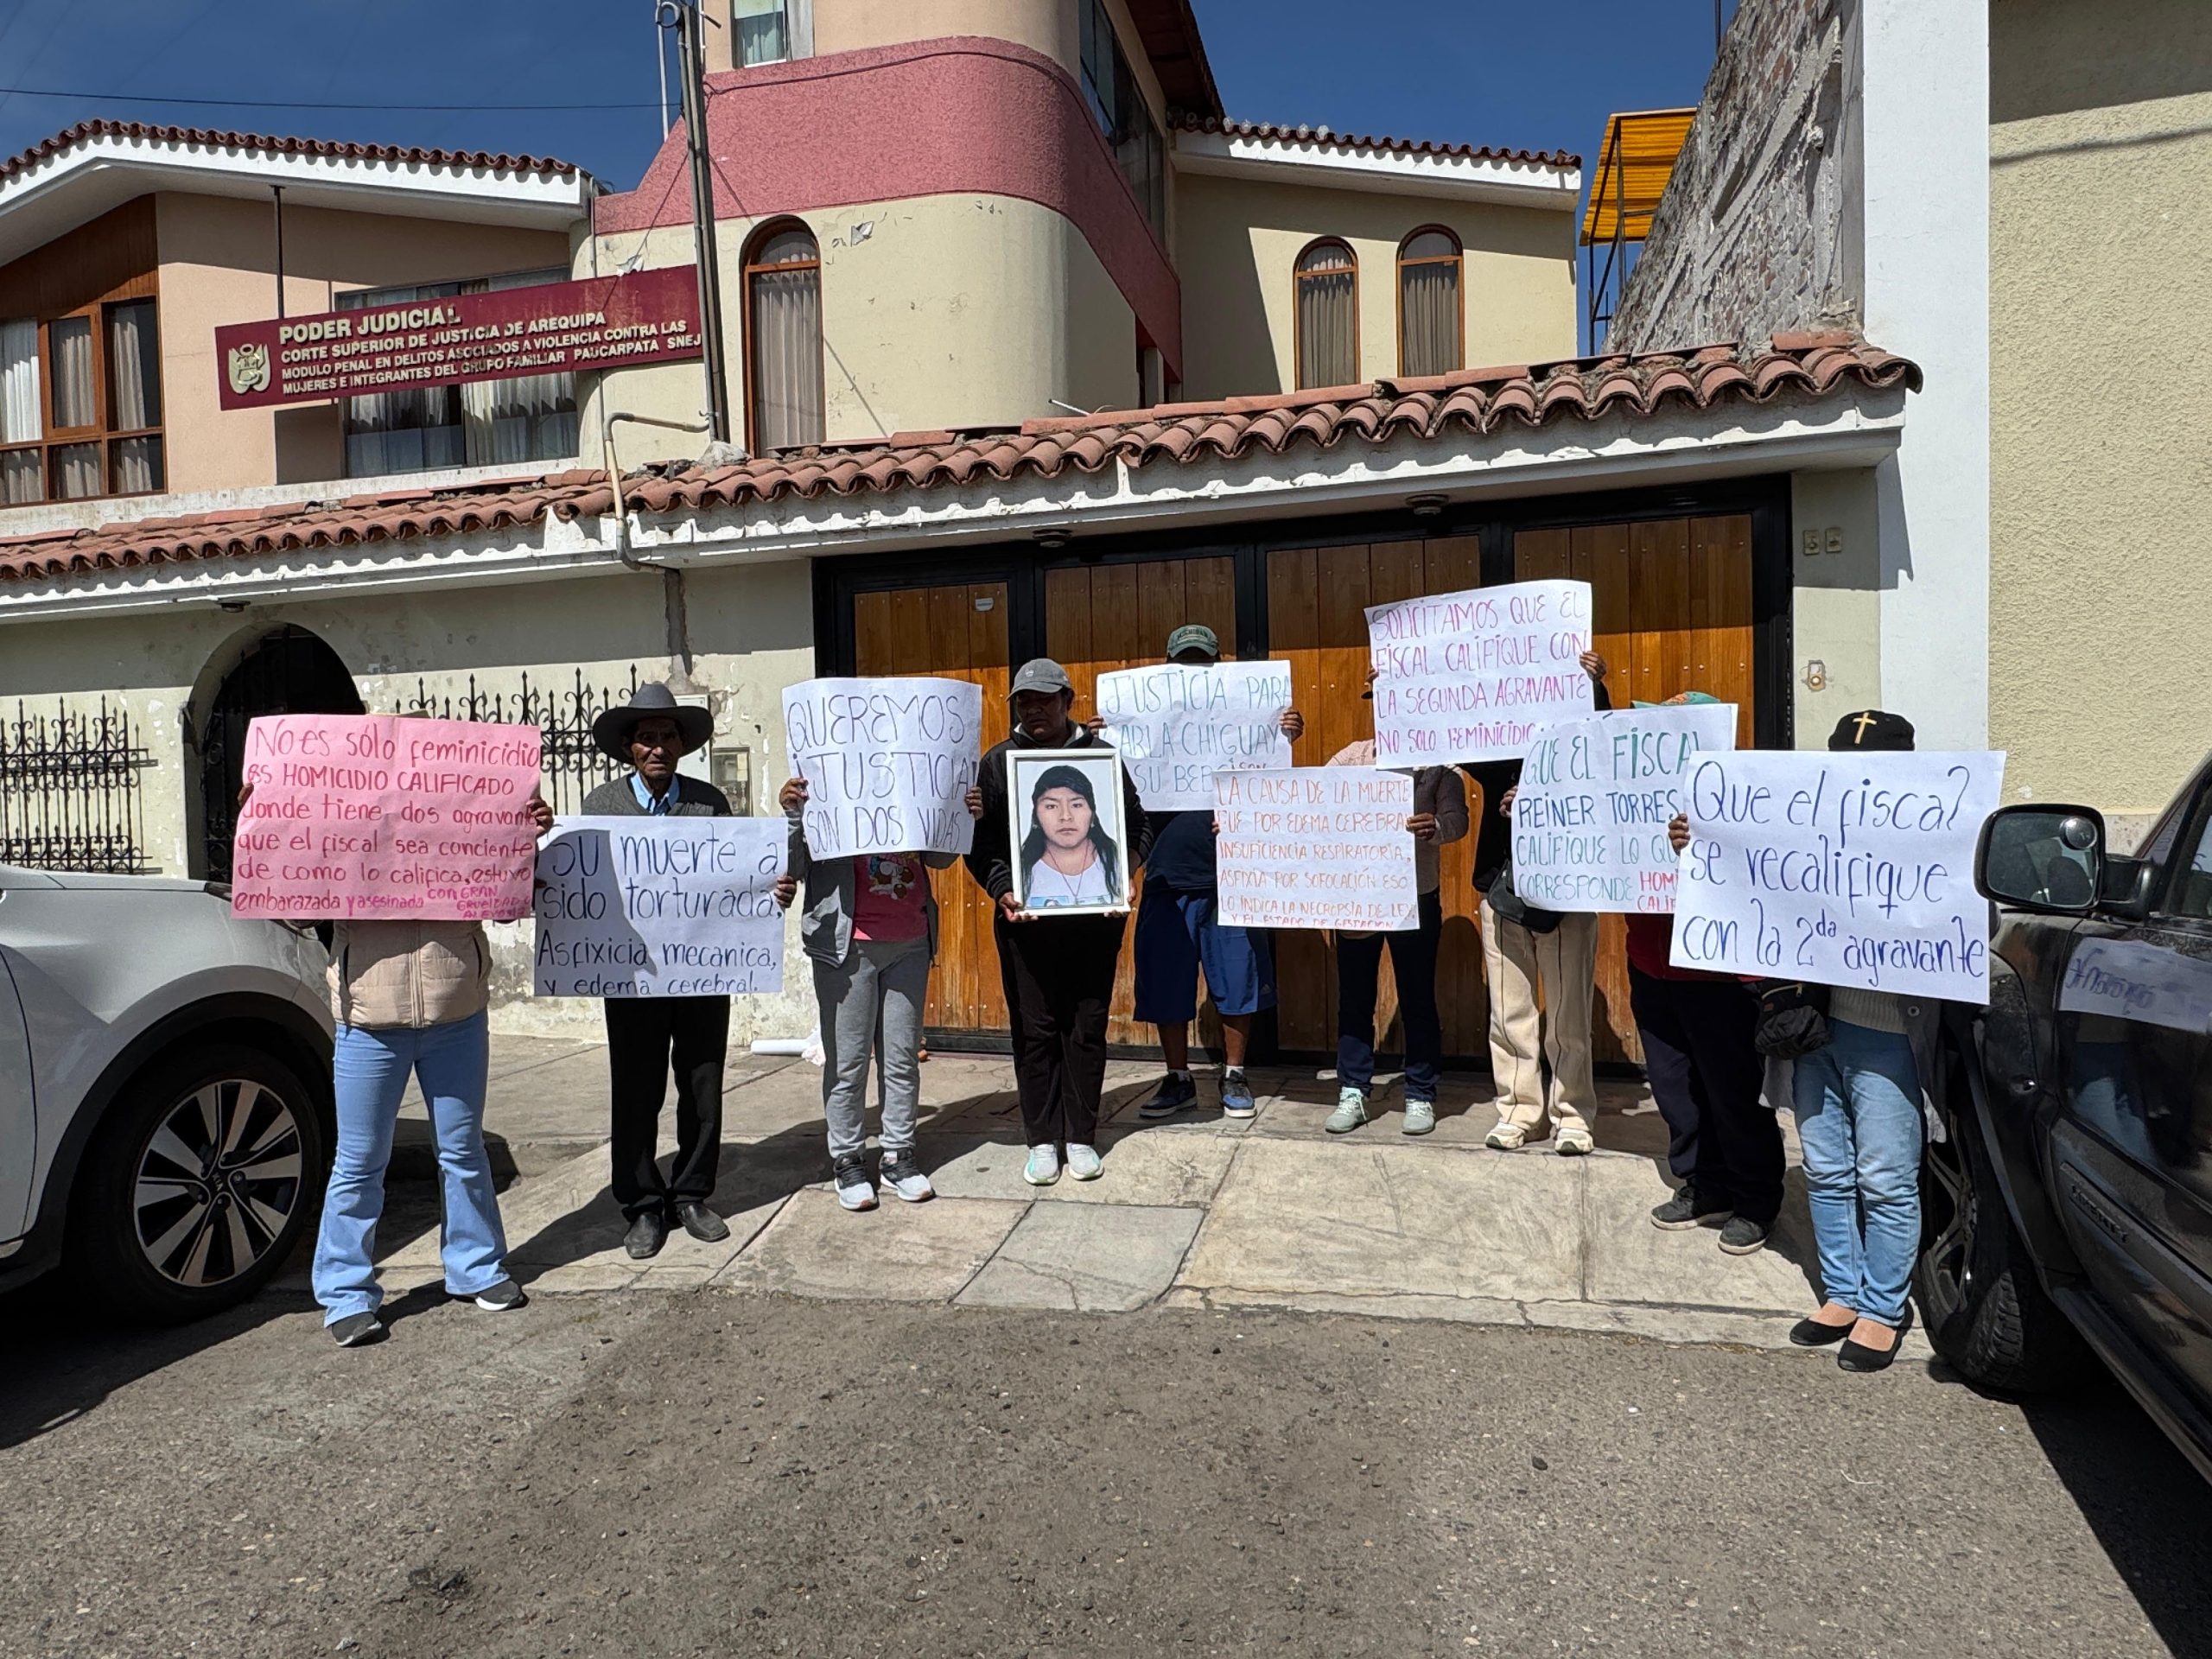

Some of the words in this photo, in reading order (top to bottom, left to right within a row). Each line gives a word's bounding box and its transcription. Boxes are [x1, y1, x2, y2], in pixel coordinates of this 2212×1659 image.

[279, 319, 352, 344] PODER
[357, 305, 461, 335] JUDICIAL
[281, 346, 328, 364] CORTE
[331, 337, 405, 358] SUPERIOR
[409, 334, 428, 348] DE
[431, 323, 499, 346] JUSTICIA
[505, 321, 524, 337] DE
[528, 311, 607, 333] AREQUIPA
[282, 363, 332, 379] MODULO
[334, 358, 372, 374] PENAL
[375, 355, 391, 370] EN
[394, 349, 445, 367] DELITOS
[448, 342, 519, 361] ASOCIADOS
[522, 339, 532, 351] A
[533, 330, 601, 350] VIOLENCIA
[604, 323, 658, 341] CONTRA
[661, 319, 687, 334] LAS
[283, 378, 337, 395] MUJERES
[340, 377, 347, 388] E
[350, 366, 432, 387] INTEGRANTES
[435, 363, 458, 377] DEL
[461, 357, 505, 374] GRUPO
[506, 351, 565, 369] FAMILIAR
[574, 340, 659, 360] PAUCARPATA
[667, 334, 702, 350] SNEJ
[1510, 594, 1547, 625] QUE
[1560, 591, 1586, 619] EL
[1376, 643, 1435, 680] FISCAL
[1549, 630, 1588, 661] CON
[1246, 675, 1291, 709] PARA
[1376, 689, 1397, 719] LA
[1405, 681, 1488, 715] SEGUNDA
[1494, 672, 1587, 707] AGRAVANTE
[787, 694, 964, 752] QUEREMOS
[1378, 729, 1400, 755] NO
[1408, 728, 1437, 753] SOLO
[346, 722, 396, 760] sólo
[410, 739, 540, 768] feminicidio
[1570, 735, 1596, 780] EL
[283, 762, 388, 791] HOMICIDIO
[397, 770, 515, 796] CALIFICADO
[1134, 764, 1160, 793] SU
[1174, 764, 1227, 793] BEB
[1216, 776, 1241, 806] LA
[1247, 777, 1300, 804] CAUSA
[1306, 779, 1325, 804] DE
[1333, 780, 1352, 804] LA
[1357, 779, 1410, 804] MUERTE
[1693, 760, 1771, 823] Que
[1787, 770, 1826, 827] el
[321, 793, 382, 821] tiene
[401, 800, 440, 824] dos
[1217, 810, 1242, 834] FUE
[1254, 810, 1282, 835] POR
[1287, 811, 1331, 834] EDEMA
[1336, 812, 1408, 833] CEREBRA
[1518, 791, 1596, 829] REINER
[1605, 789, 1679, 825] TORRES
[238, 832, 280, 855] que
[289, 826, 311, 851] el
[321, 830, 378, 858] fiscal
[395, 840, 429, 856] sea
[438, 836, 533, 858] conciente
[620, 822, 735, 875] muerte
[758, 842, 779, 875] a
[806, 806, 841, 854] SON
[854, 805, 904, 849] DOS
[917, 806, 961, 852] VIDAS
[238, 856, 270, 880] de
[282, 865, 346, 881] como
[361, 862, 380, 882] lo
[1219, 868, 1267, 889] ASFIXIA
[1274, 871, 1299, 888] POR
[1382, 874, 1408, 890] ESO
[1518, 872, 1634, 902] CORRESPONDE
[1689, 839, 1727, 886] se
[1745, 834, 1948, 919] recalifique
[234, 887, 340, 912] embarazada
[427, 887, 457, 900] con
[542, 877, 606, 920] sido
[1220, 895, 1236, 912] LO
[1282, 900, 1295, 915] LA
[1368, 903, 1384, 918] DE
[1231, 913, 1238, 925] Y
[1313, 918, 1328, 927] DE
[537, 929, 648, 969] Asfixicia
[1682, 914, 1739, 963] con
[1750, 898, 1782, 967] la
[1842, 916, 1985, 987] agravante
[543, 979, 556, 996] y
[574, 973, 651, 995] edema
